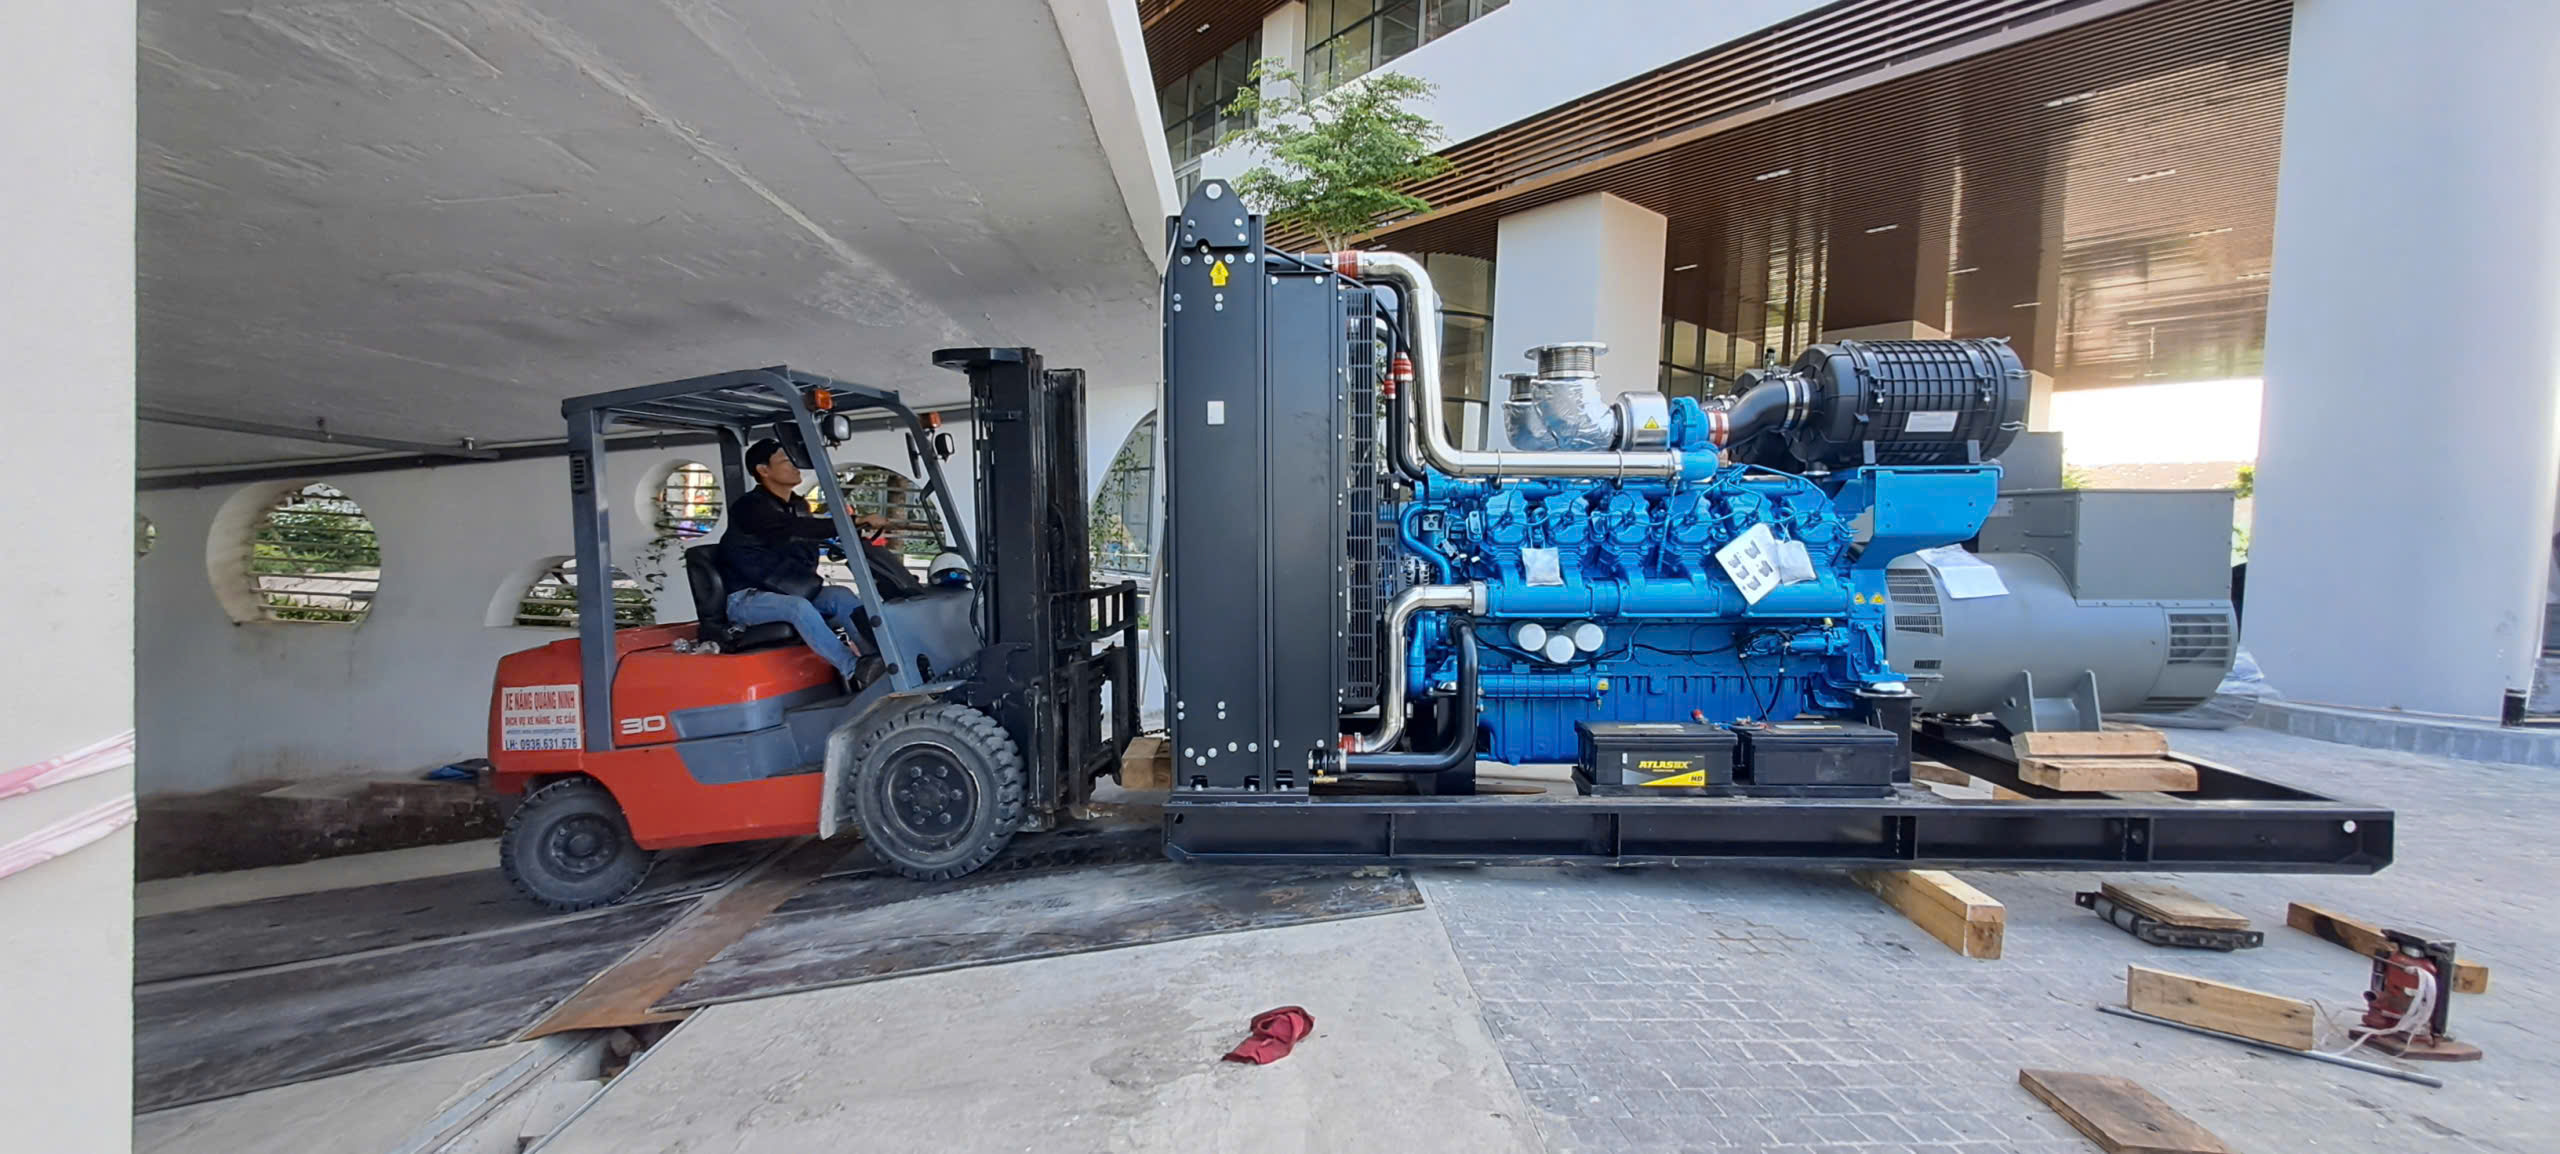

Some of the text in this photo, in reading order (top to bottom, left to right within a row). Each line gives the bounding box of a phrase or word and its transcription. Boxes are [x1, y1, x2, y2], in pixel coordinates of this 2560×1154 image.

[505, 692, 513, 711] XE
[558, 691, 575, 709] NINH
[620, 715, 666, 734] 30
